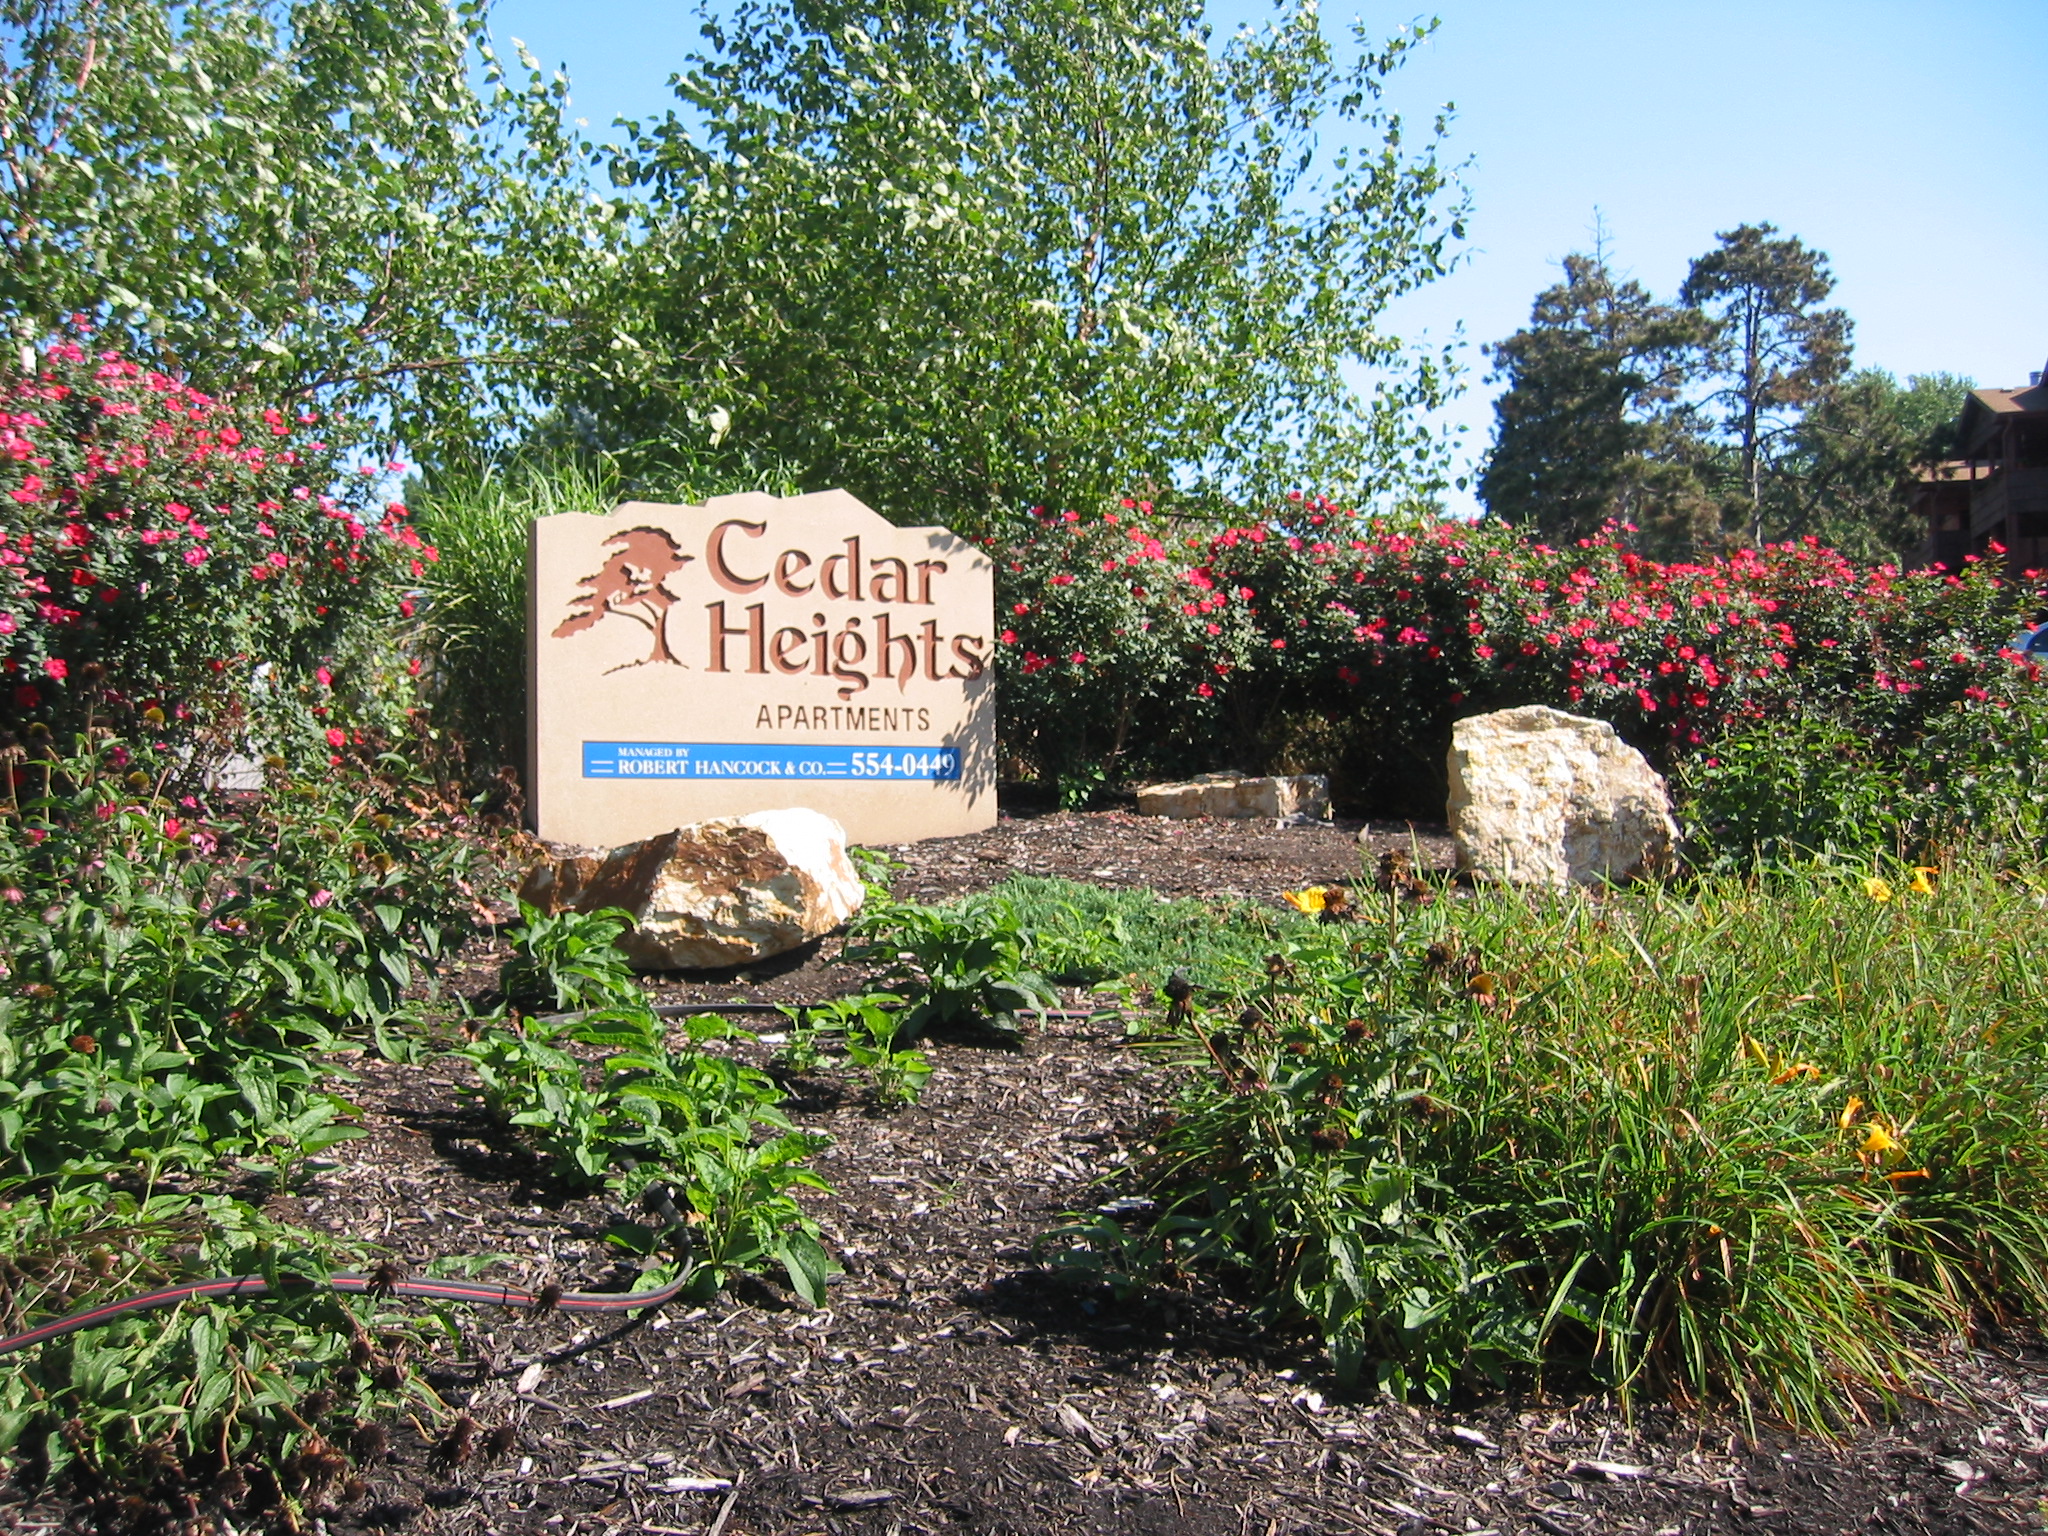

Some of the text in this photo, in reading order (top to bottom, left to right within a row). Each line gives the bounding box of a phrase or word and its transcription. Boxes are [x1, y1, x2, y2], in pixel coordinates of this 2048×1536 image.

[705, 519, 948, 605] Cedar
[705, 601, 984, 701] Heights
[756, 704, 930, 732] APARTMENTS
[617, 747, 690, 758] MANAGED BY
[618, 751, 956, 777] ROBERT HANCOCK & CO. 554-0449
